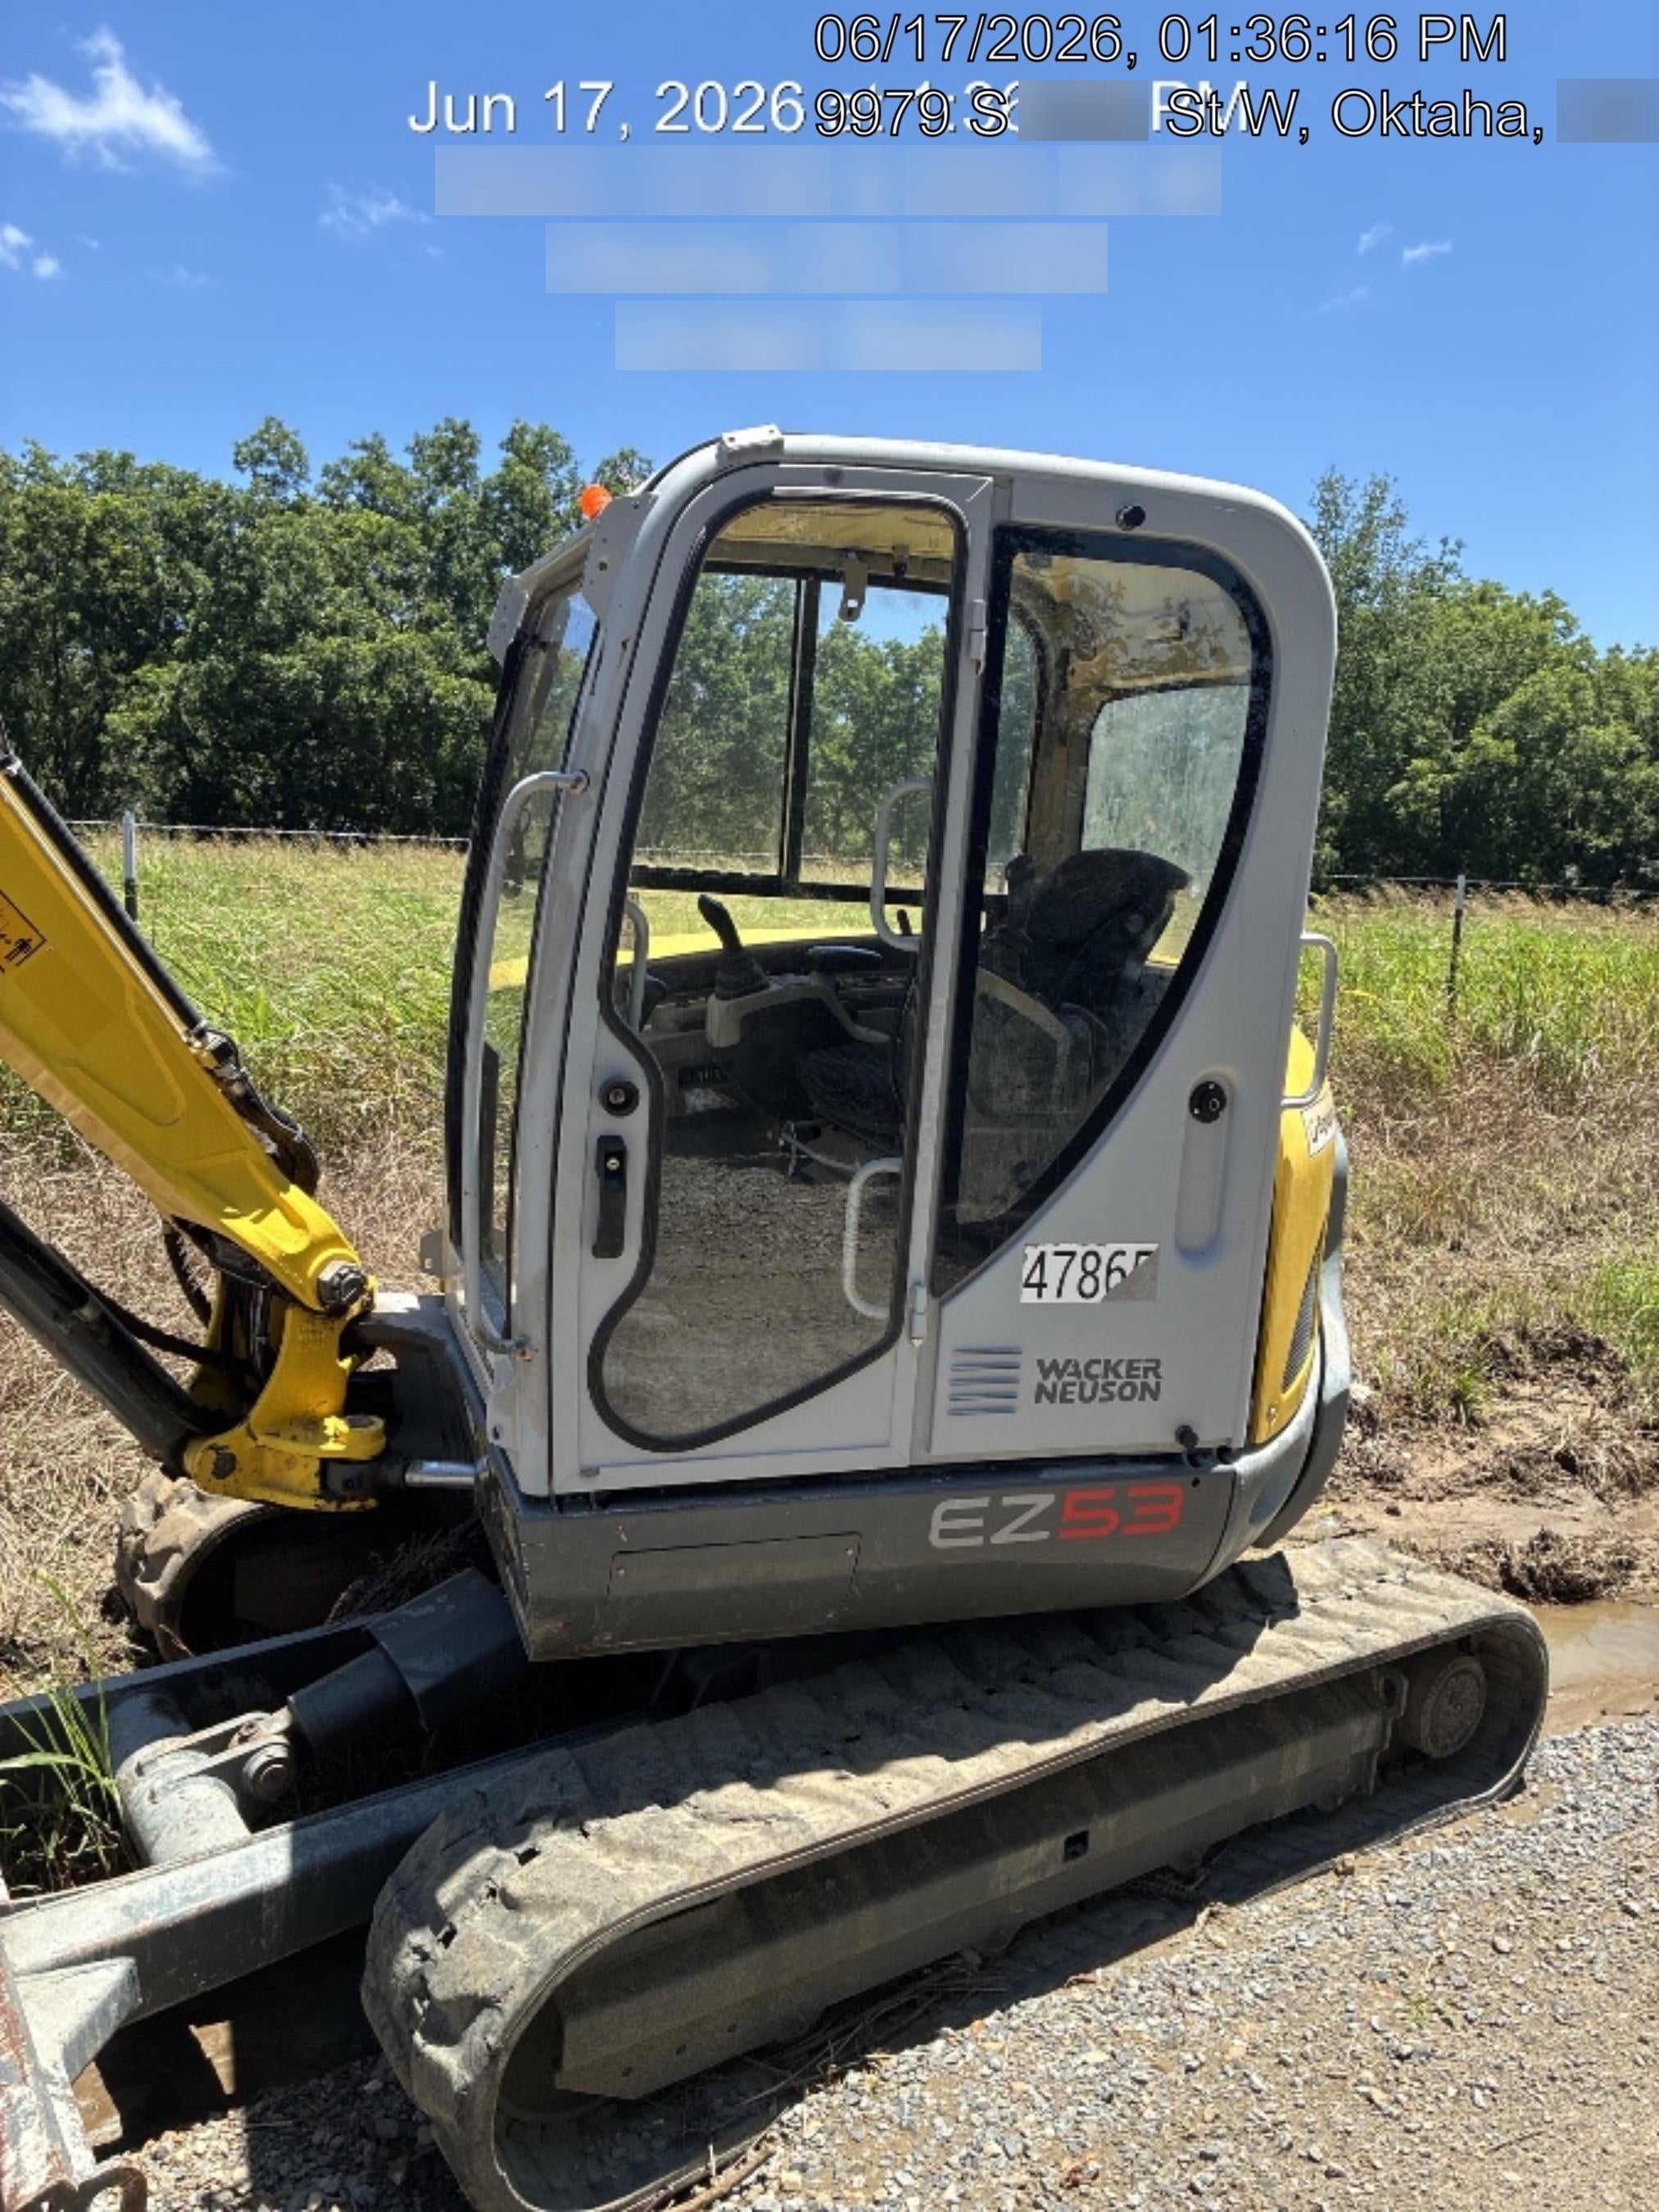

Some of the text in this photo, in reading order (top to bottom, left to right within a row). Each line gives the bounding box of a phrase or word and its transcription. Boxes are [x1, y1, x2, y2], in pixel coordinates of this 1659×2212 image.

[1022, 1250, 1154, 1299] 4786
[1036, 1358, 1163, 1380] WACKER
[1034, 1380, 1162, 1404] NEUSON
[928, 1484, 1184, 1548] EZ53
